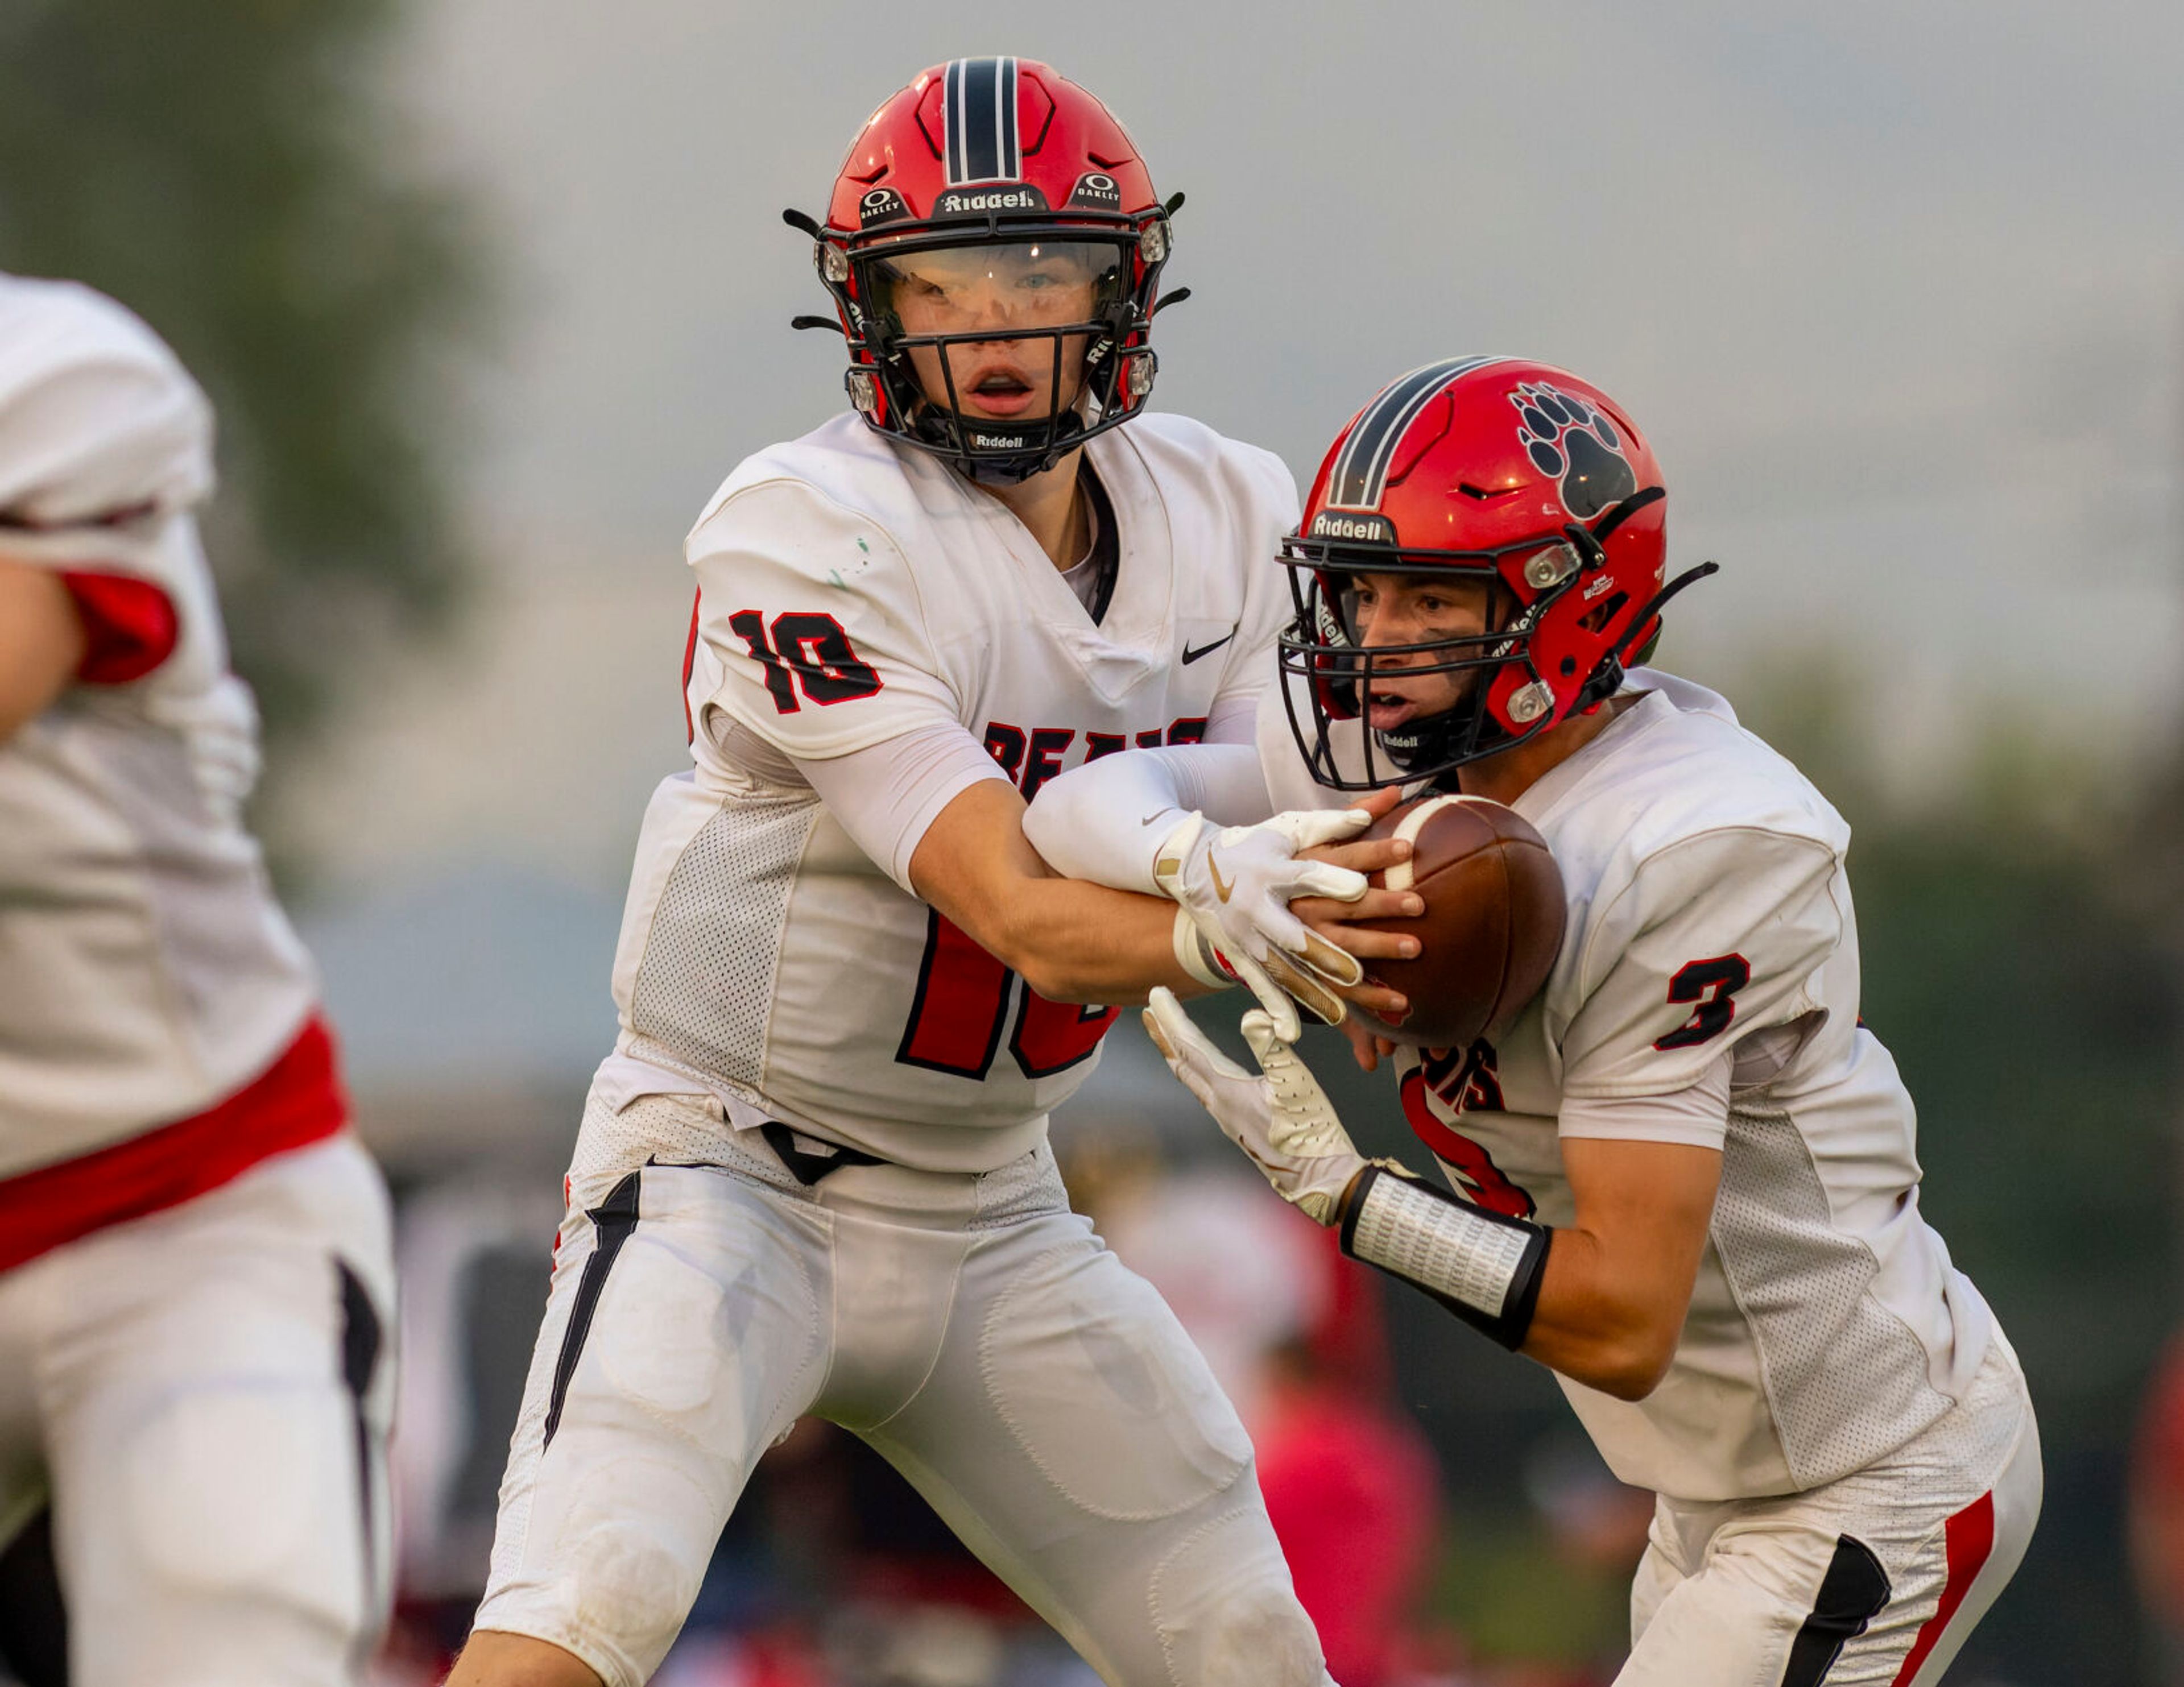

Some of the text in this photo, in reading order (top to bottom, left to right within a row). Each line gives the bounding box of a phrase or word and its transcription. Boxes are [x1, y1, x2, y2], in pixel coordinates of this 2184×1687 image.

[1078, 188, 1119, 201] OAKLEY
[860, 201, 900, 219] OAKLEY
[977, 434, 1023, 447] Riddell
[1314, 513, 1381, 540] Riddell
[729, 609, 885, 715] 10
[1652, 952, 1751, 1051] 3
